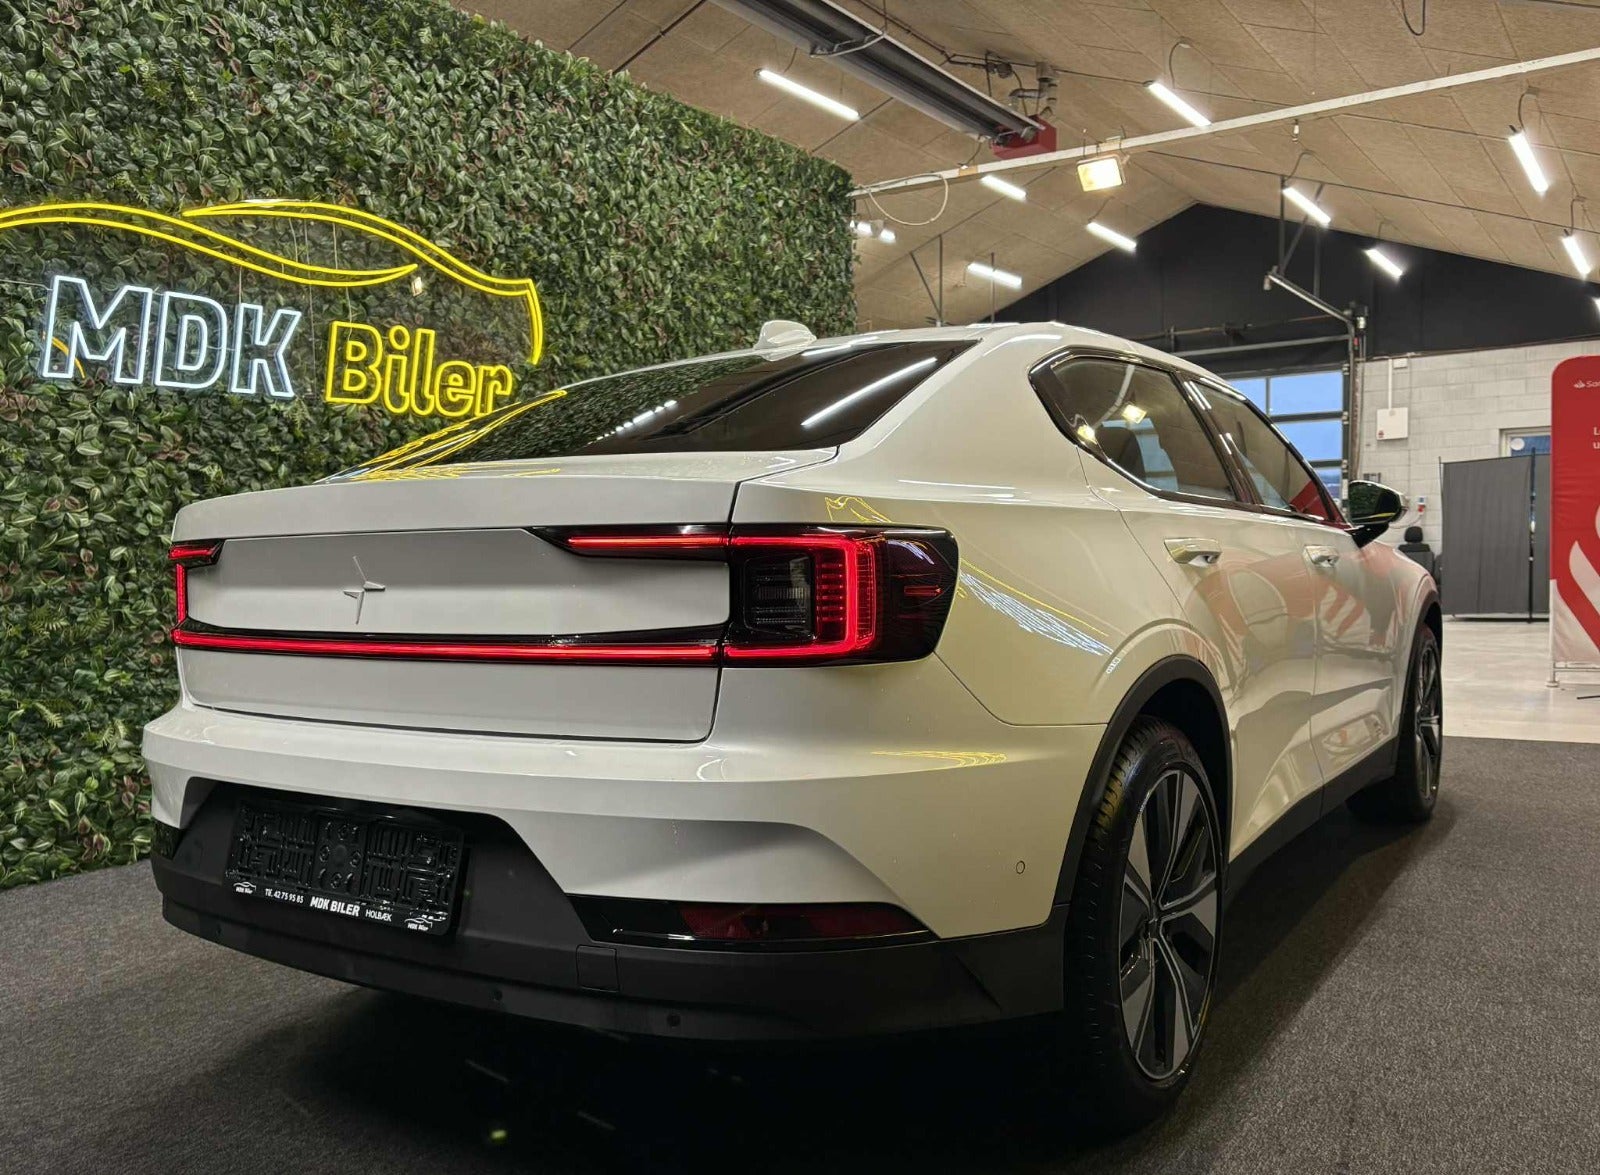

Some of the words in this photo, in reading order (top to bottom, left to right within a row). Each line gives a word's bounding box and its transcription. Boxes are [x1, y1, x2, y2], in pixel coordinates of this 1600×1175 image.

[41, 273, 302, 399] MDK
[324, 320, 513, 418] Biler
[310, 896, 331, 911] MDK
[329, 899, 360, 917] BILER
[365, 909, 392, 922] HOLBÆK
